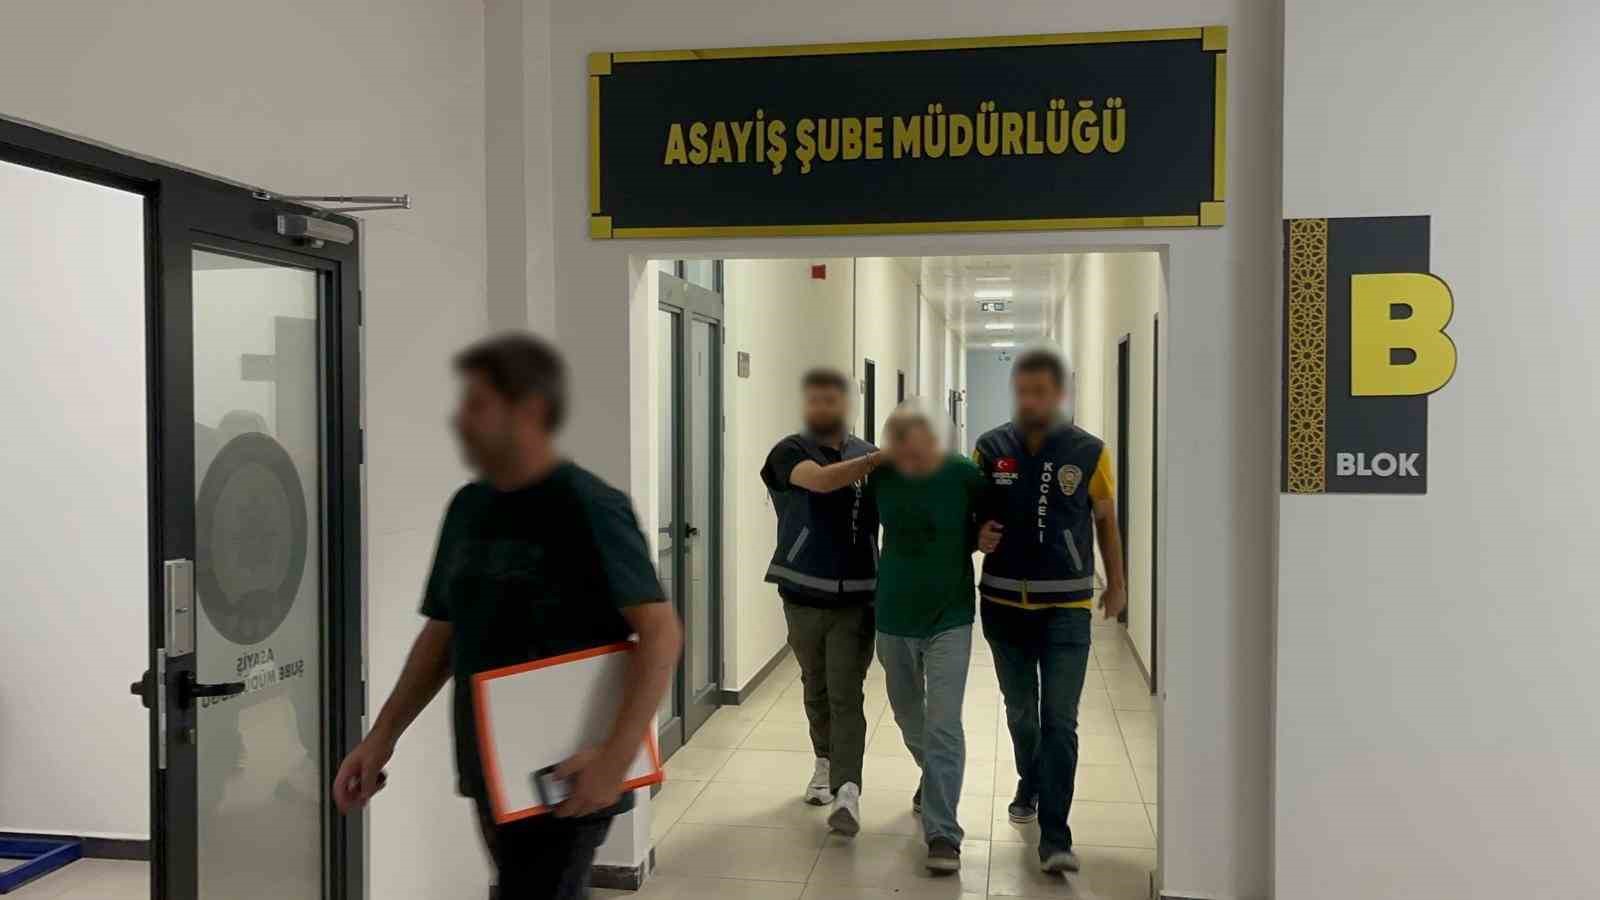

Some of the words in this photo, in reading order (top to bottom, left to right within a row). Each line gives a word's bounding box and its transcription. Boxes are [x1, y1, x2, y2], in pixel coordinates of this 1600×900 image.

[664, 109, 788, 175] ASAYİŞ
[795, 117, 884, 175] ŞUBE
[892, 97, 1127, 159] MÜDÜRLÜĞÜ
[1350, 272, 1457, 396] B
[1336, 452, 1420, 477] BLOK
